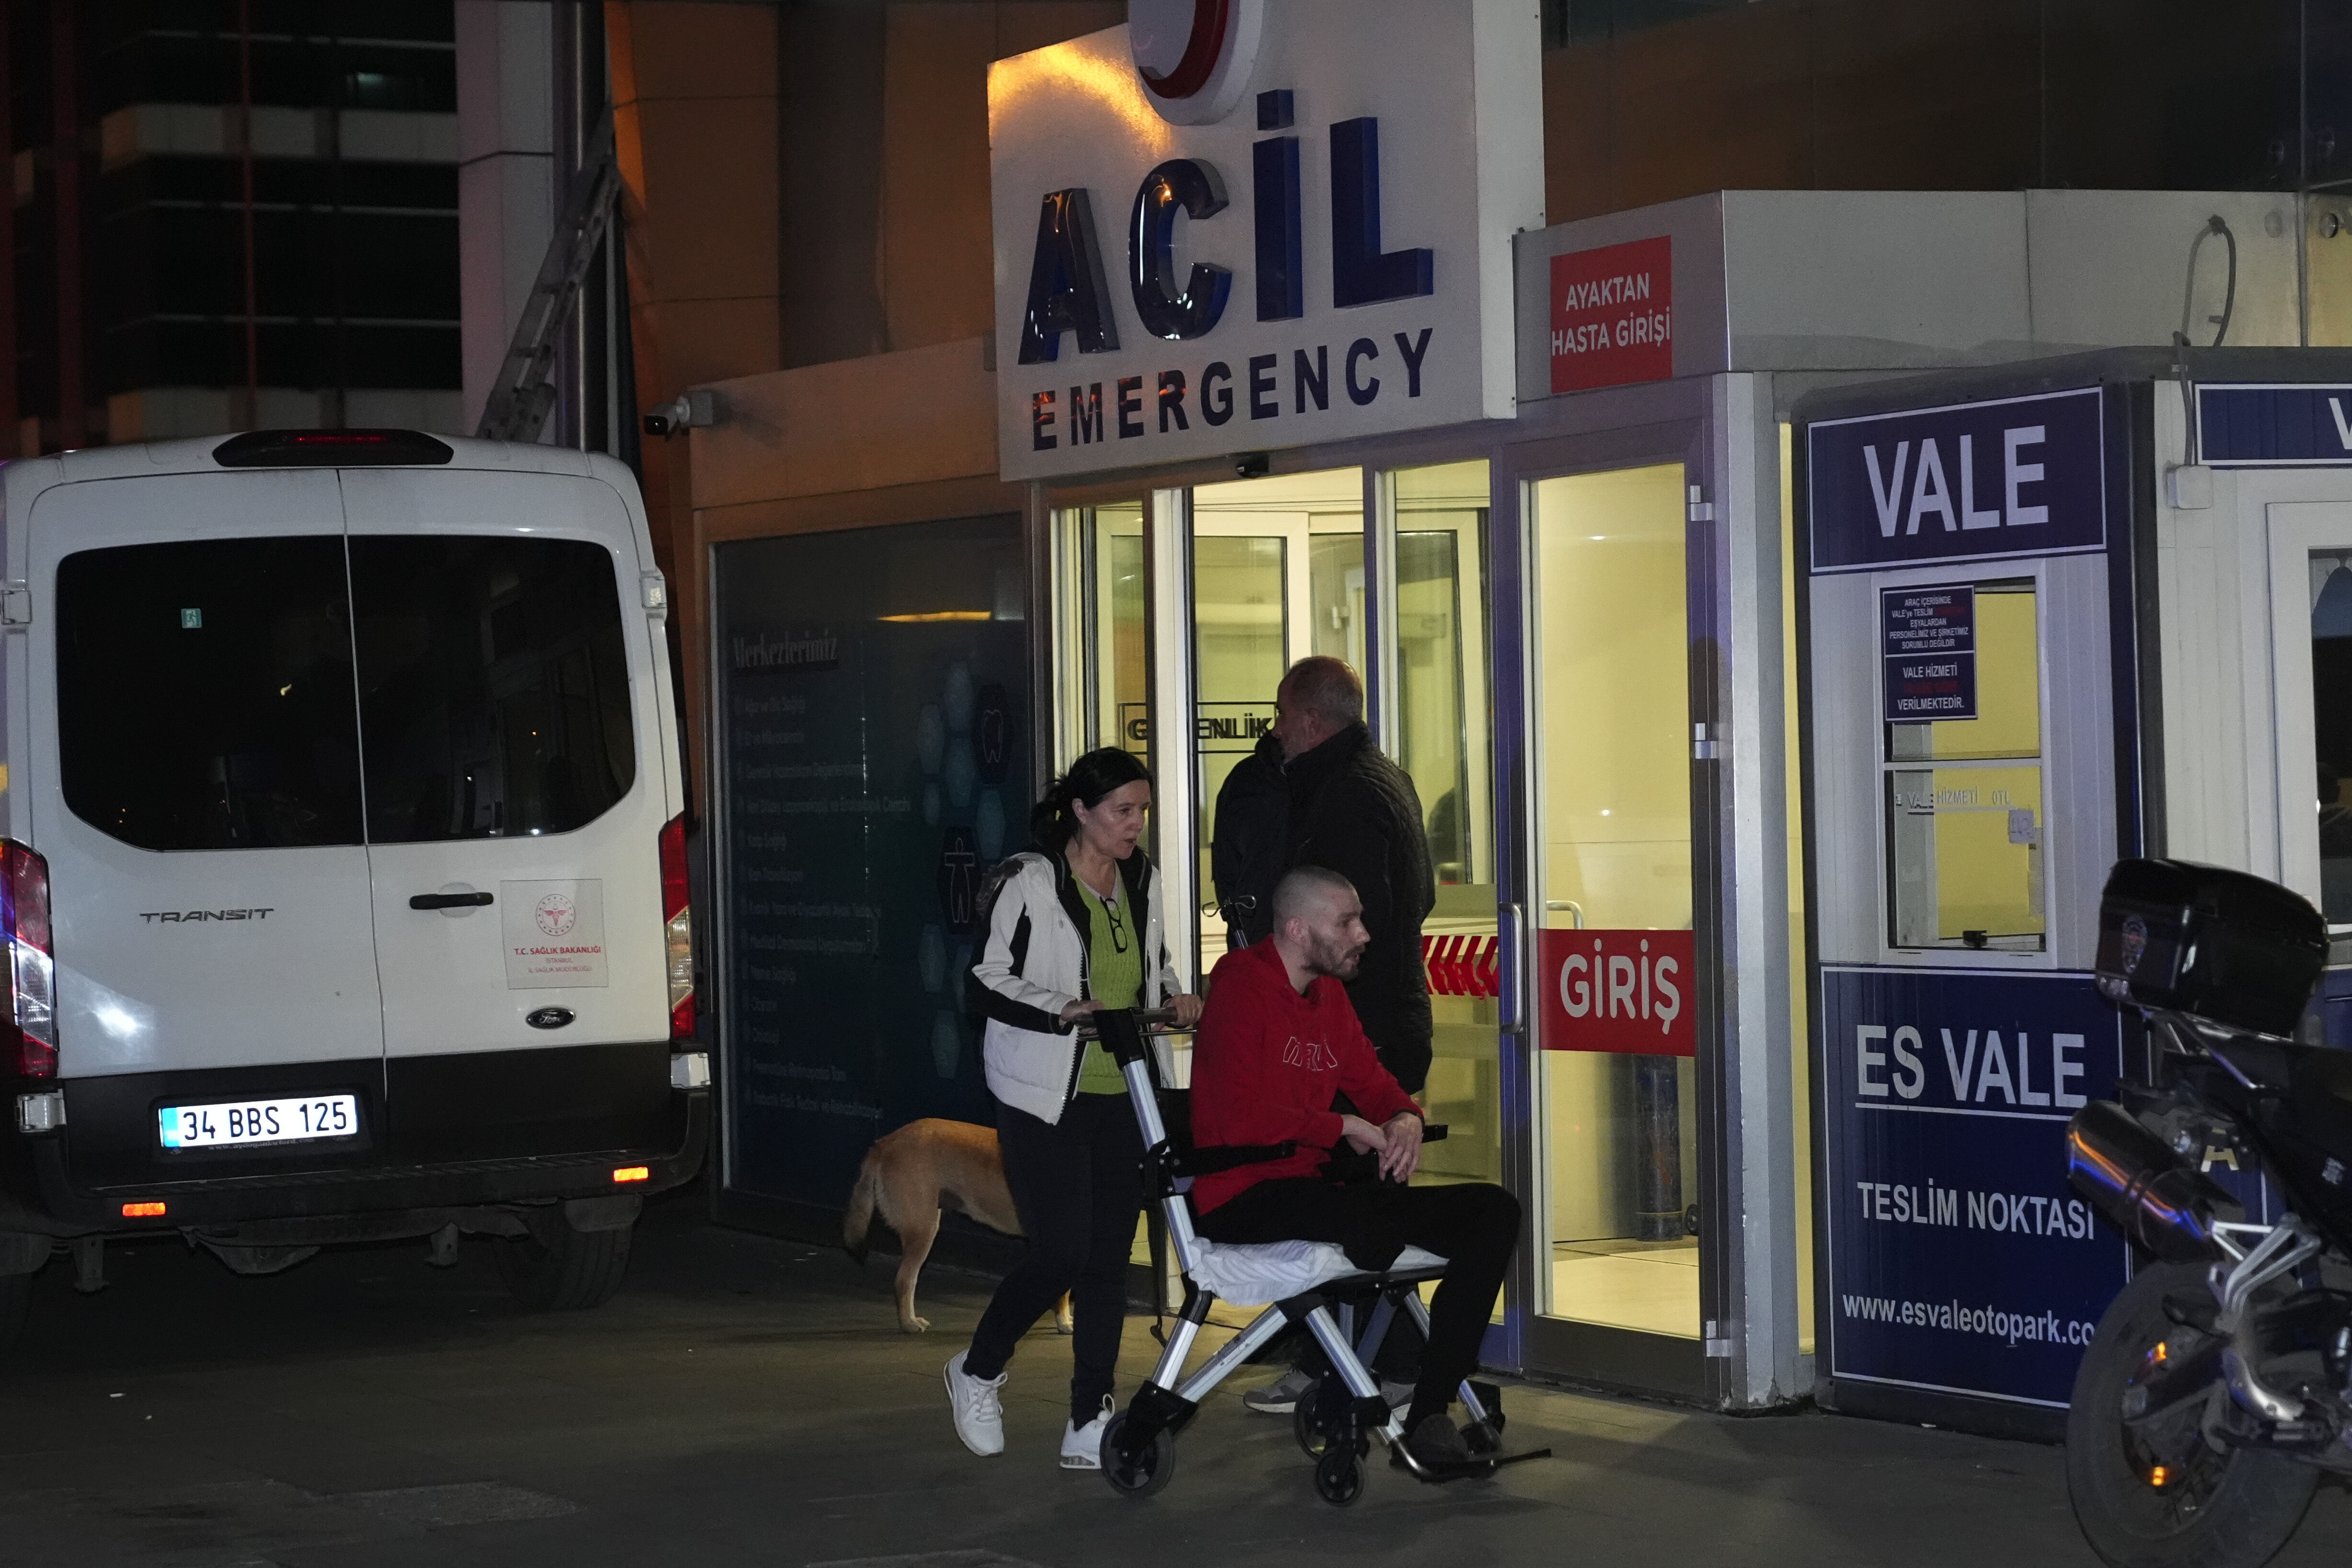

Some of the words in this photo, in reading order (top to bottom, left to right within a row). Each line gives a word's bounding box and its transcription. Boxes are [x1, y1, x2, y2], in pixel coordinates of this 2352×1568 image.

[1018, 89, 1433, 365] ACİL
[1566, 273, 1649, 311] AYAKTAN
[1552, 323, 1610, 356] HASTA
[1616, 306, 1671, 347] GİRİŞİ
[1032, 328, 1433, 451] EMERGENCY
[1863, 425, 2049, 537] VALE
[1904, 598, 1920, 607] ARAÇ
[1914, 606, 1933, 616] TESLİM
[1902, 640, 1928, 649] SORUMLU
[1930, 629, 1937, 637] VE
[1903, 666, 1924, 678] VALE
[1925, 662, 1957, 677] HİZMETİ
[139, 908, 274, 923] TRANSIT
[530, 946, 558, 955] SAĞLIK
[560, 945, 601, 954] BAKANLIĞI
[1560, 938, 1680, 1035] GİRİŞ
[1857, 1025, 1925, 1099] ES
[1940, 1028, 2087, 1108] VALE
[183, 1110, 216, 1140] 34
[229, 1106, 280, 1138] BBS
[300, 1101, 346, 1132] 125
[1857, 1178, 1958, 1227] TESLİM
[1968, 1190, 2094, 1240] NOKTASI
[1842, 1294, 2095, 1346] www.esvaleotopark.co
